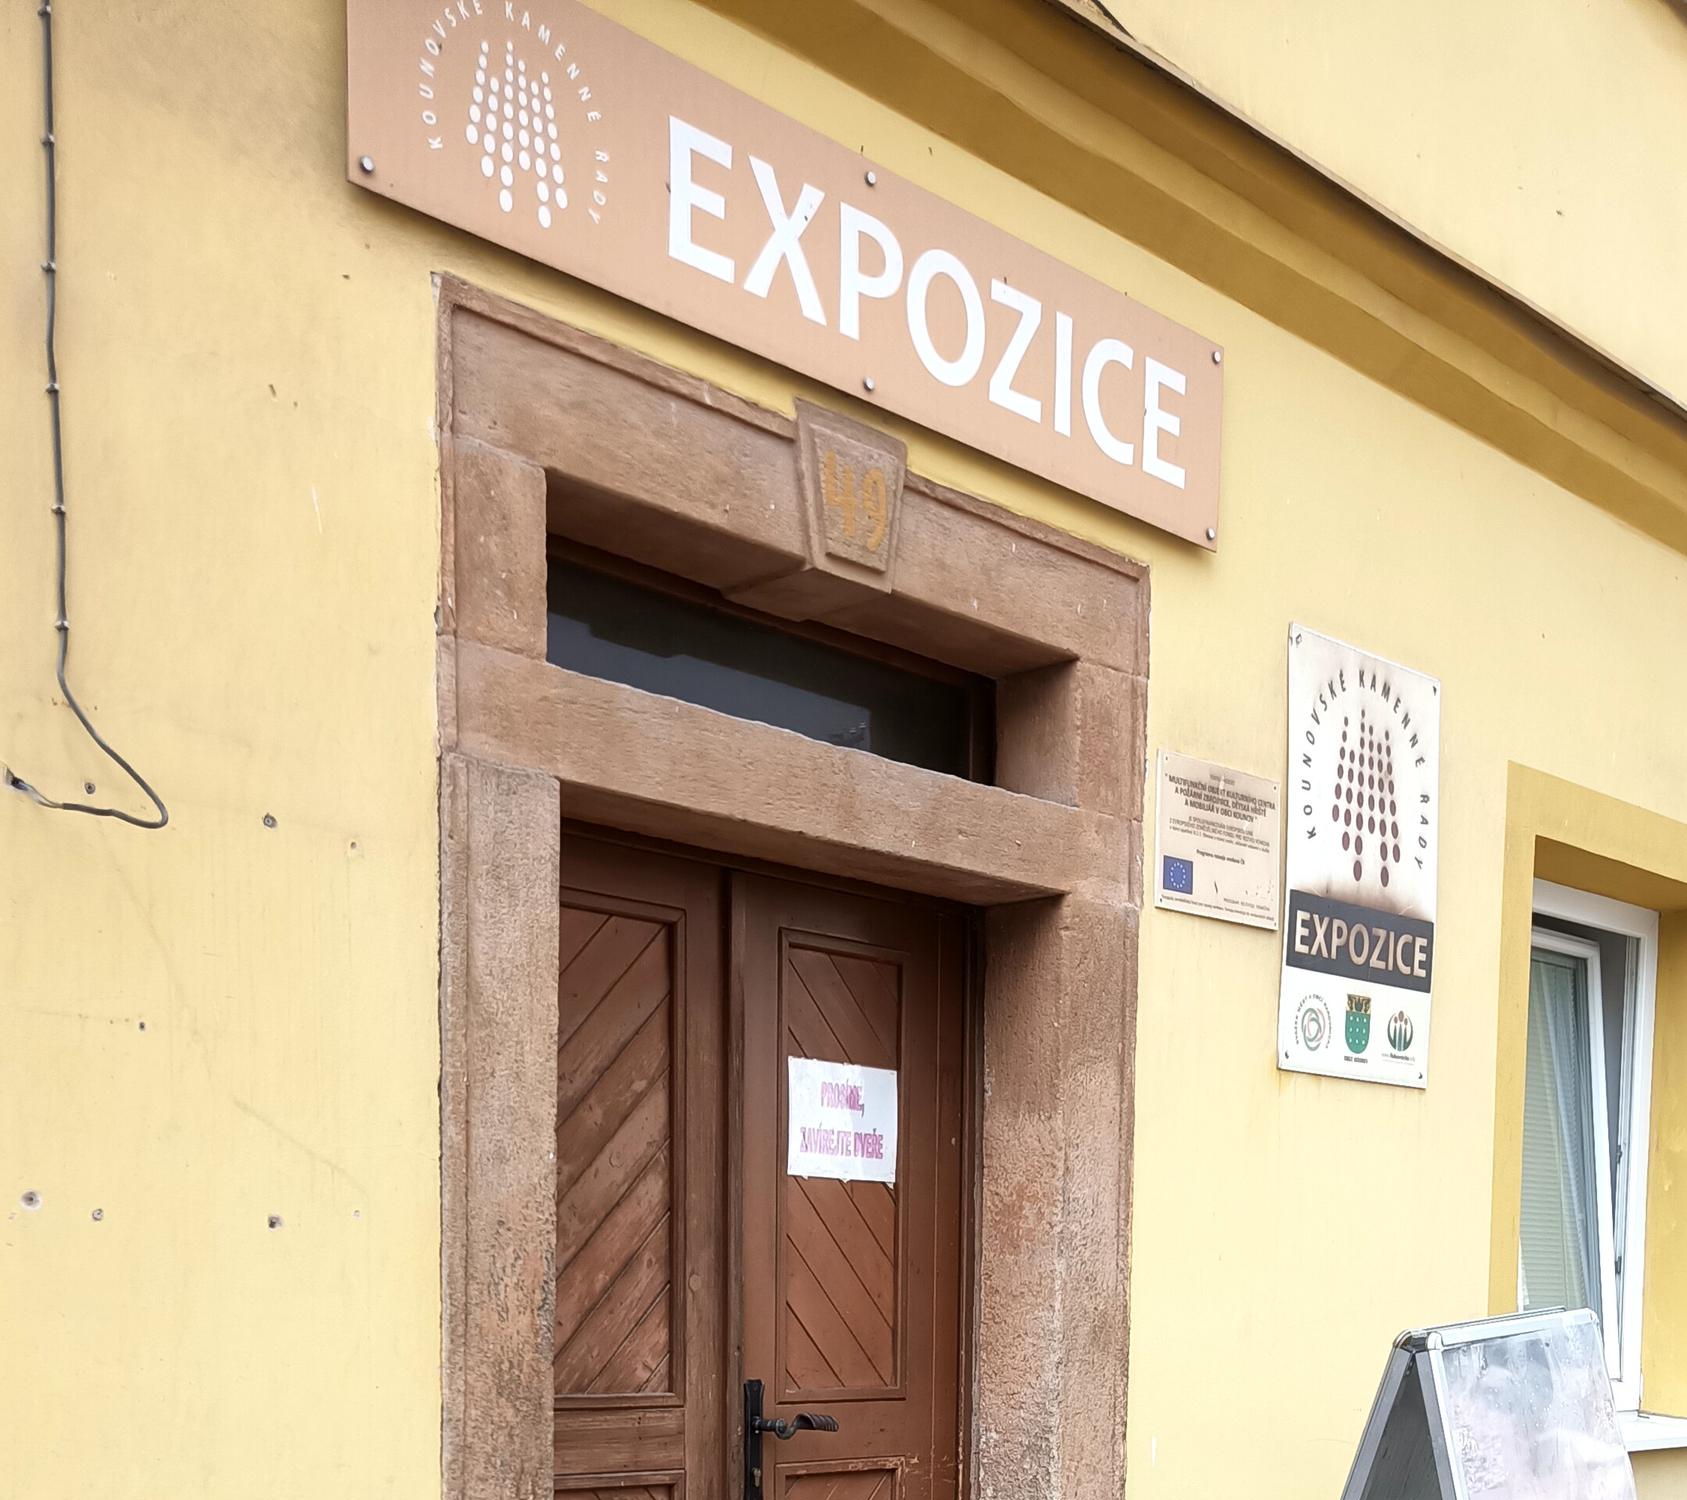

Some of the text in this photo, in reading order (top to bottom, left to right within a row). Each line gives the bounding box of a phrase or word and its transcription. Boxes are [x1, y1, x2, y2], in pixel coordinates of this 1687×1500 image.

[668, 114, 1187, 490] EXPOZICE
[824, 448, 888, 553] 49
[1294, 909, 1428, 978] EXPOZICE
